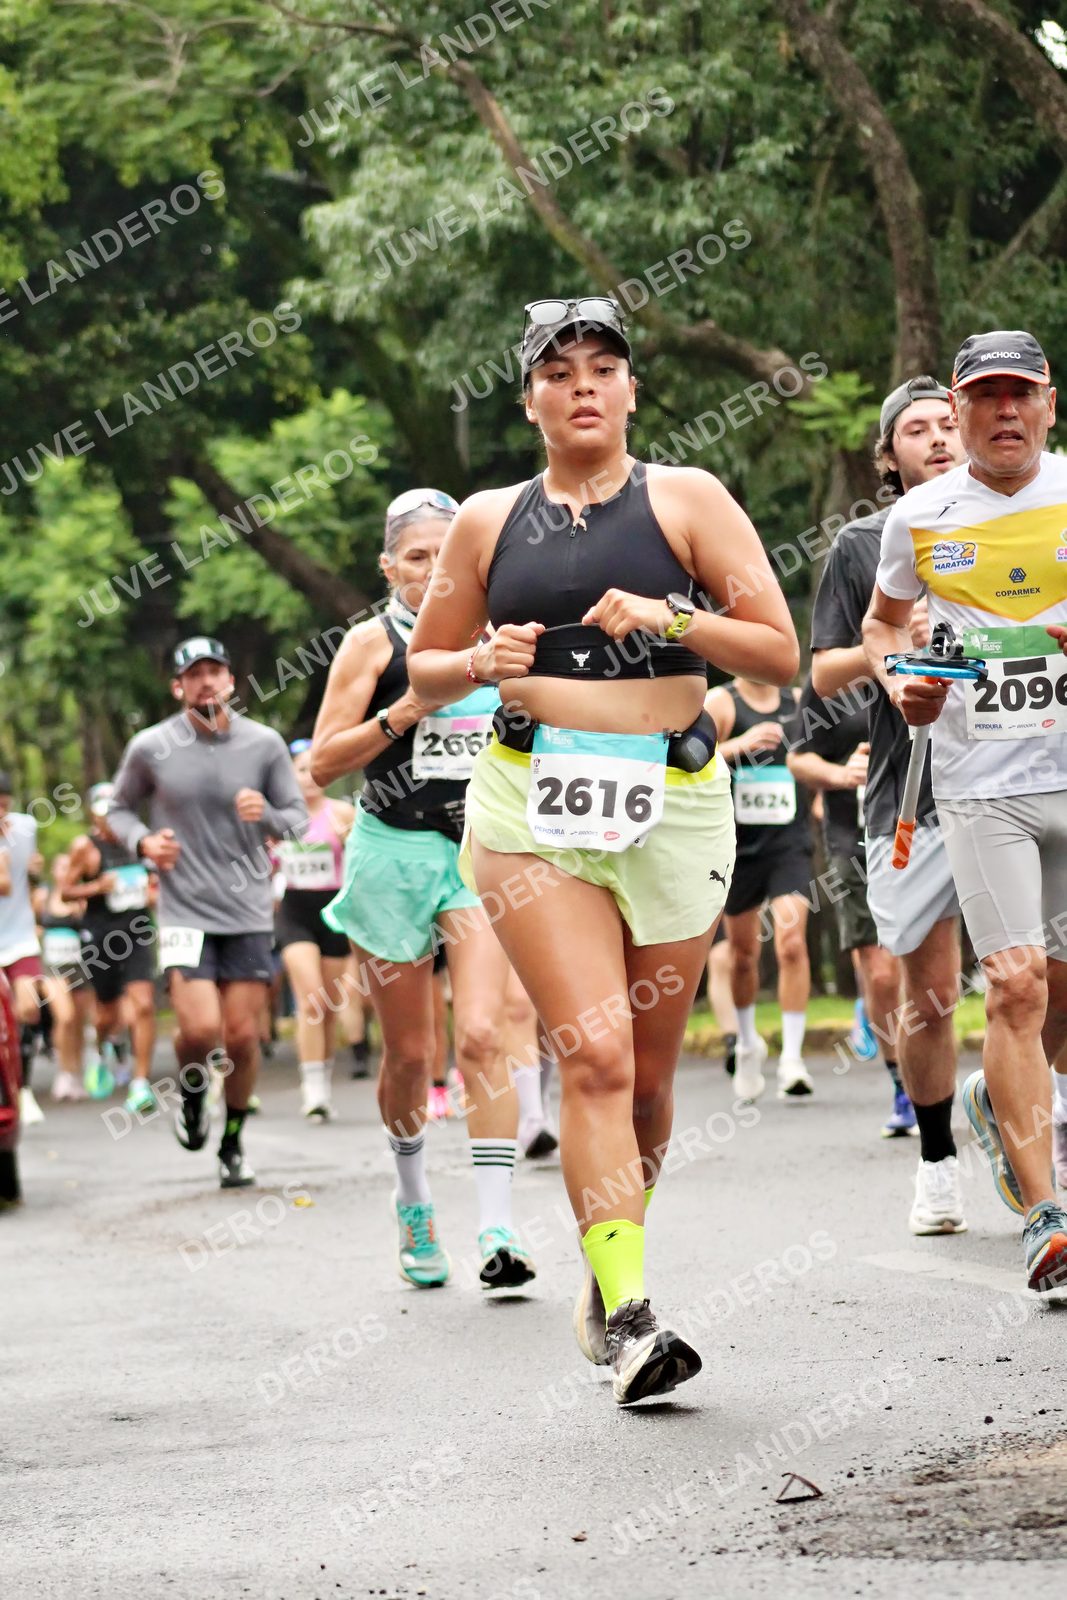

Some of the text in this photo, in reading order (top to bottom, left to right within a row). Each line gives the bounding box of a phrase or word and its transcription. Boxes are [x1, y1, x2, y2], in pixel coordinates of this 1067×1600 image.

[980, 351, 1021, 362] BACHOCO
[934, 558, 975, 571] MARATÓN
[995, 587, 1041, 598] COPARMEX
[536, 776, 655, 823] 2616
[741, 792, 791, 809] 5624
